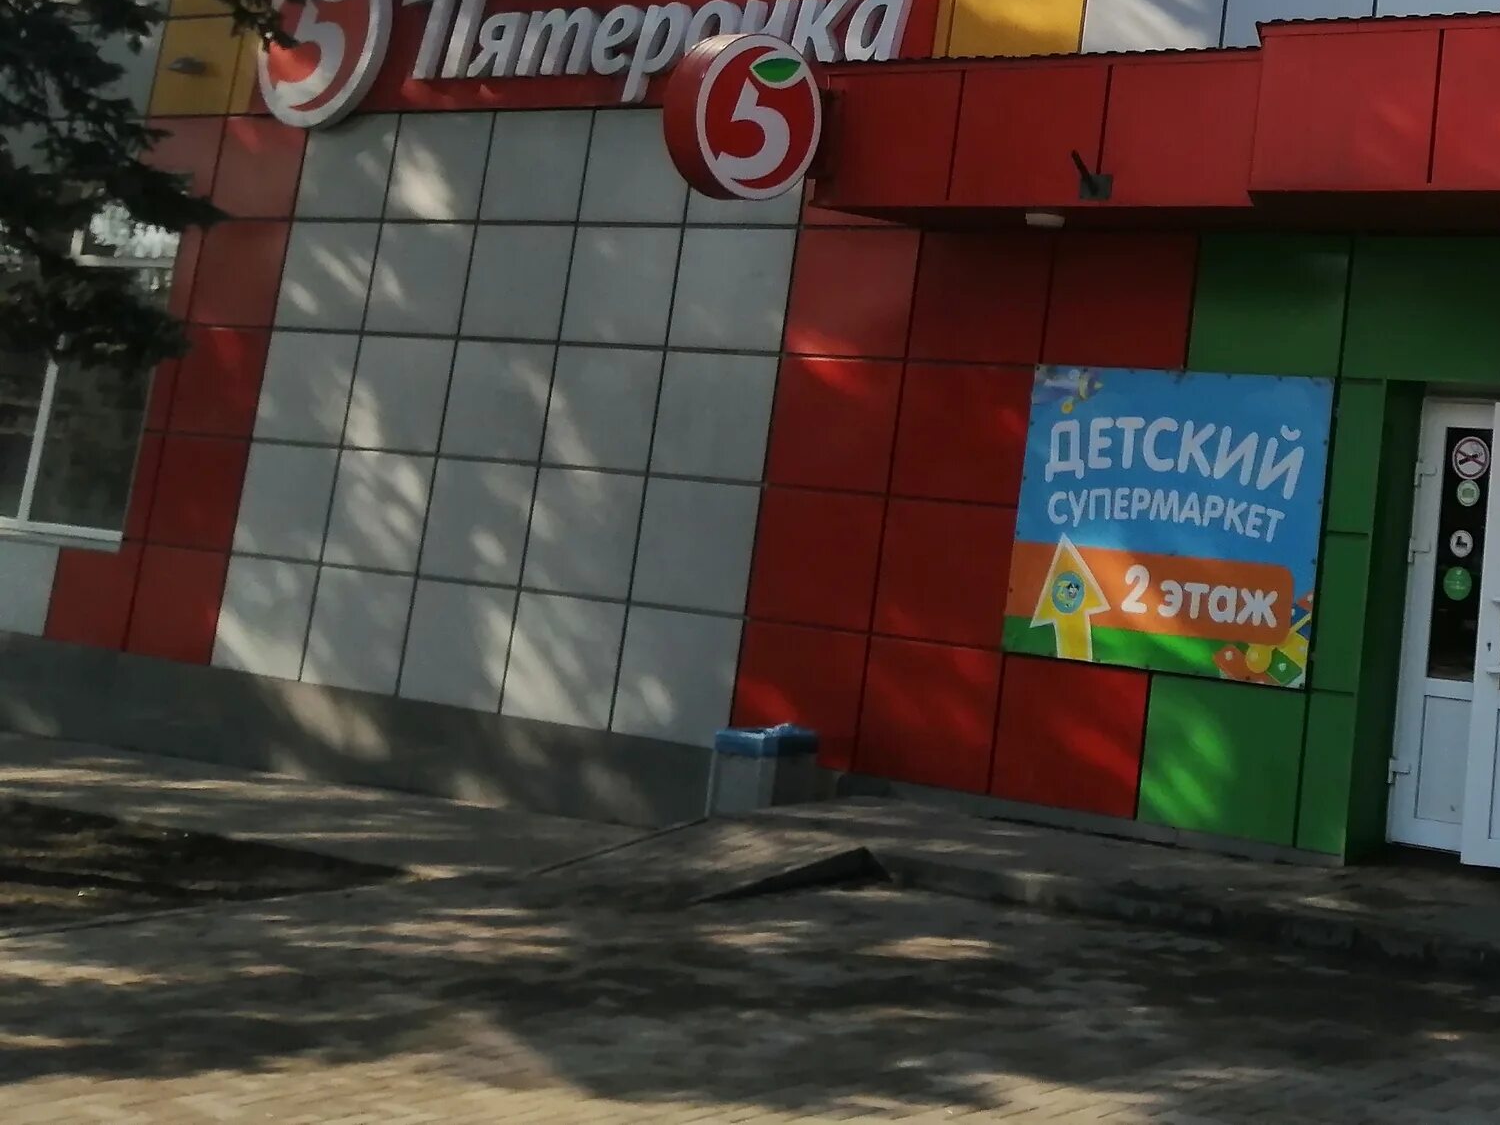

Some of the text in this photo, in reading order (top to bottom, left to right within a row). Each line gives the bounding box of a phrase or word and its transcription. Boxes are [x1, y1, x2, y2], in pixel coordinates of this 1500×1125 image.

[1045, 416, 1305, 500] ДЕТСКИЙ
[1048, 487, 1286, 543] СУПЕРМАРКЕТ
[1121, 565, 1151, 614] 2
[1158, 579, 1279, 628] этаж
